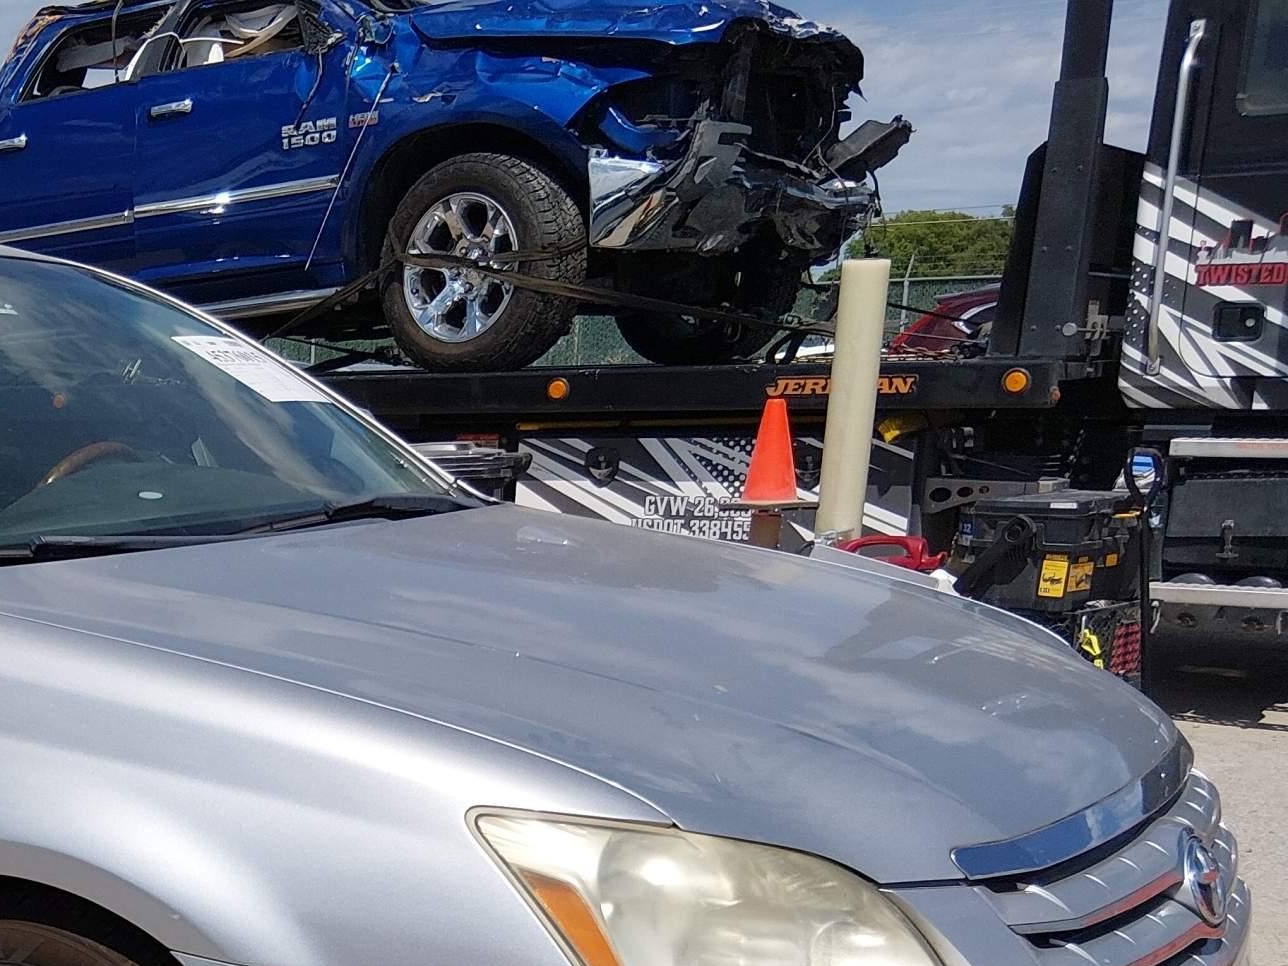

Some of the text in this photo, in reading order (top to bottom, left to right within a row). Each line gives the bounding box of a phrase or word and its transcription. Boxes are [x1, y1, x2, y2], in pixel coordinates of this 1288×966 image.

[282, 117, 337, 137] RAM
[282, 130, 337, 150] 1500
[1195, 263, 1288, 286] TWISTED
[644, 495, 689, 516] GVW
